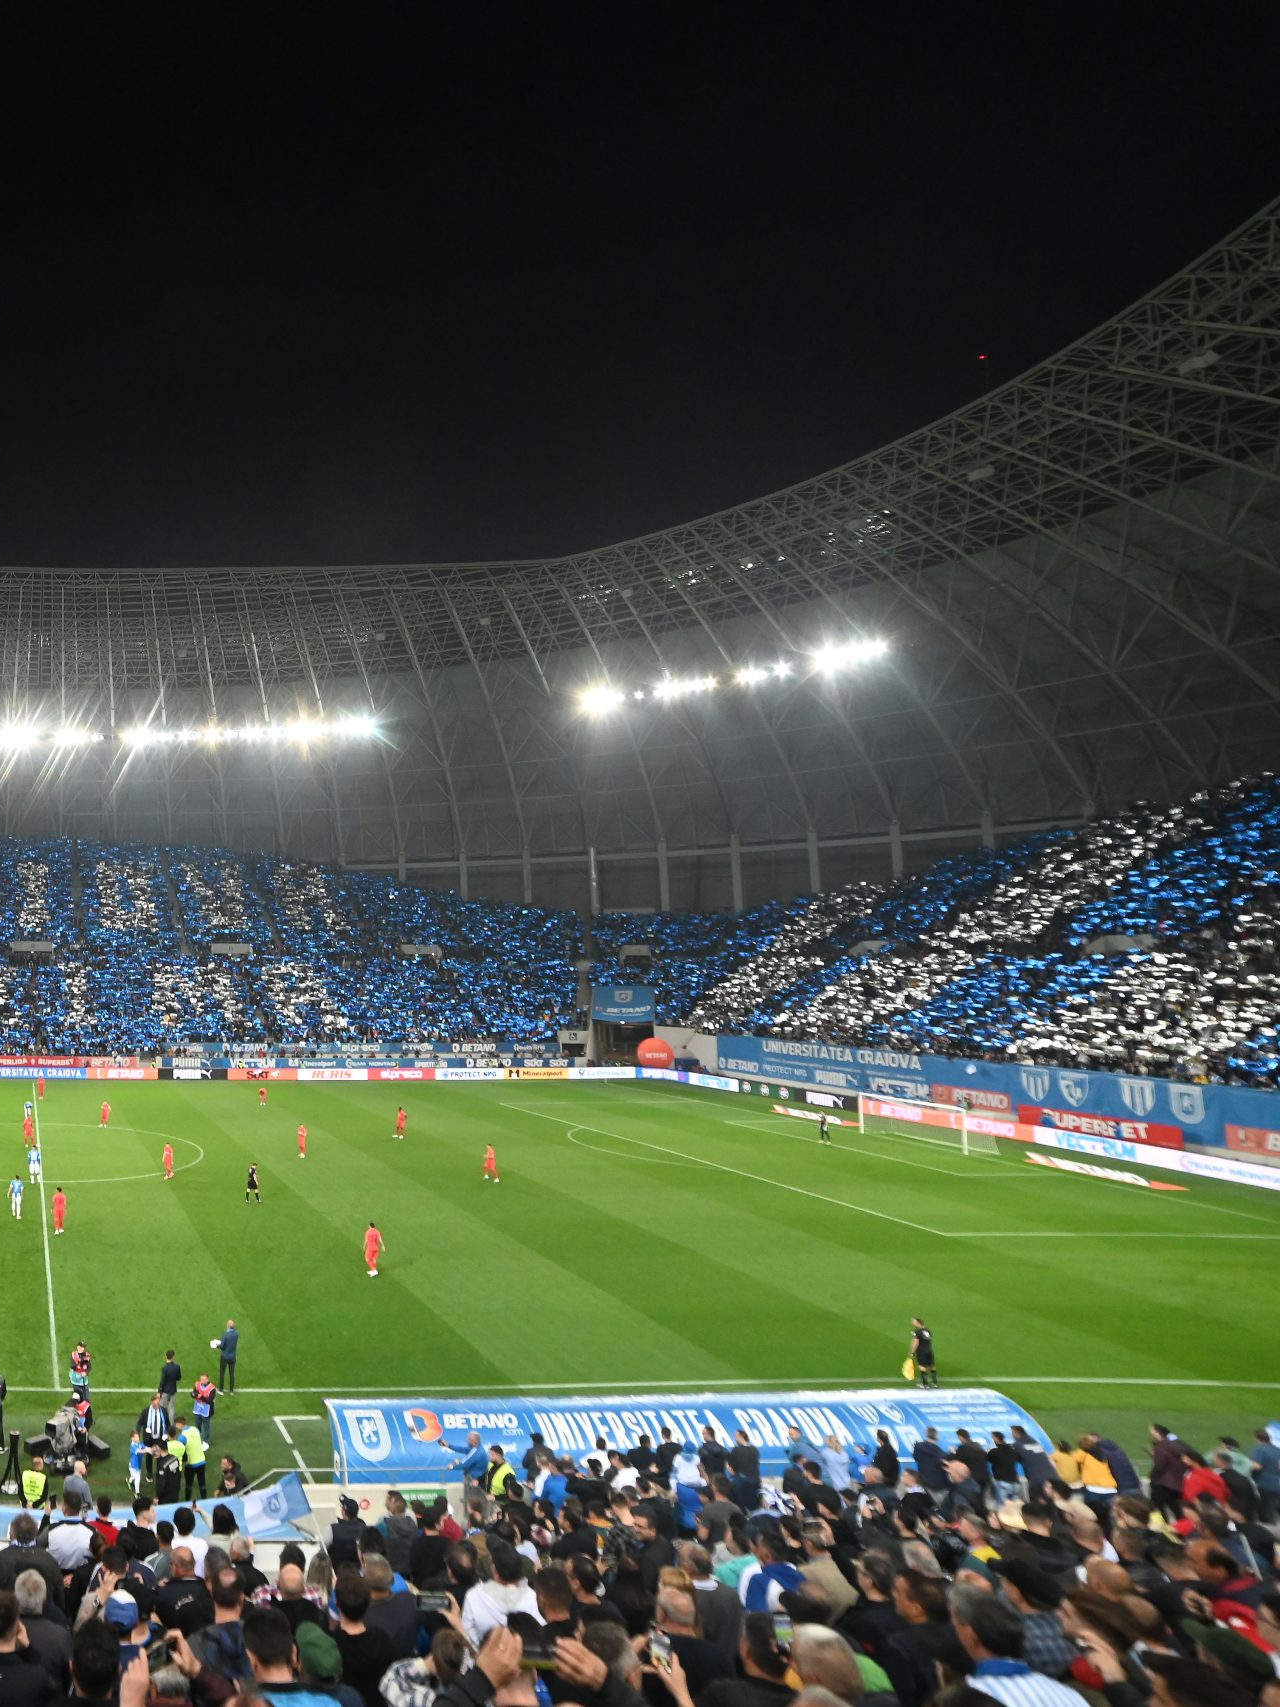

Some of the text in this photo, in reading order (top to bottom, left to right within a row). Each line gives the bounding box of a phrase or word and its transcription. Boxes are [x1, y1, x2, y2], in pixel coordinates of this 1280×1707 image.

[606, 1005, 650, 1013] BETANO
[462, 1043, 496, 1052] BETANO
[762, 1040, 853, 1063] UNIVERSITATEA
[858, 1050, 922, 1071] CRAIOVA
[38, 1058, 74, 1066] SUPERBET
[172, 1058, 200, 1067] PUMA
[727, 1058, 759, 1073] BETANO
[47, 1069, 82, 1077] CRAIOVA
[107, 1068, 145, 1078] BETANO
[173, 1069, 201, 1079] PUMA
[312, 1070, 352, 1079] RURIS
[380, 1069, 423, 1080] elpreco
[523, 1070, 563, 1079] Mineralport
[815, 1071, 847, 1087] PUMA
[880, 1104, 923, 1122] BETANO
[442, 1413, 519, 1429] BETANO
[534, 1407, 854, 1450] UNIVERSITATEA CRAIOVA
